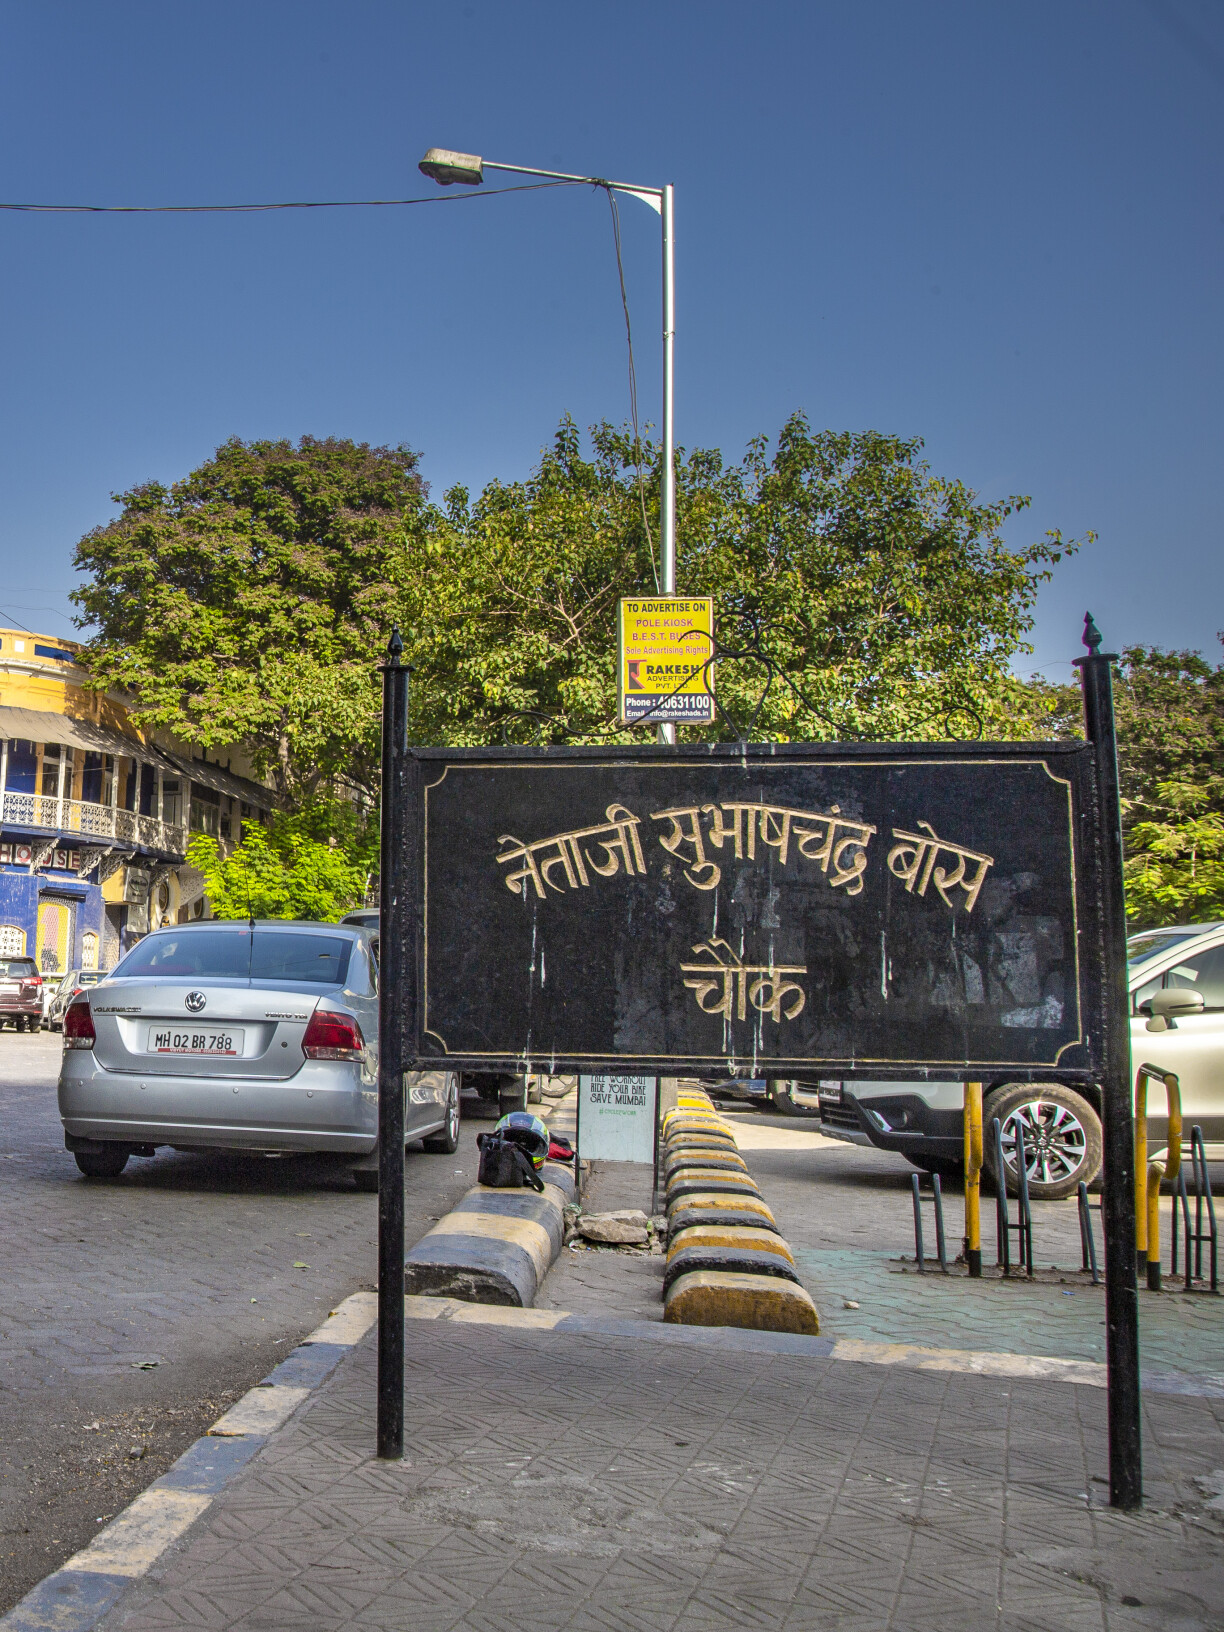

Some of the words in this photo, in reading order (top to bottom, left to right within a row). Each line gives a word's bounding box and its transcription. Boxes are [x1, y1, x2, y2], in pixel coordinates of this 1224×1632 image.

[627, 604, 639, 612] TO
[641, 603, 690, 612] ADVERTISE
[693, 603, 706, 612] ON
[636, 619, 660, 627] POLE
[663, 619, 694, 627] KIOSK
[632, 632, 666, 641] B.E.S.T.
[669, 631, 701, 641] BUSES
[626, 646, 641, 654] Sole
[643, 646, 684, 656] Advertising
[685, 645, 708, 656] Rights
[646, 665, 700, 674] RAKESH
[626, 698, 651, 706] Phone
[657, 696, 709, 709] 40631100
[496, 803, 647, 899] नेताजी
[649, 802, 876, 896] सुभाषचंद्र
[887, 820, 994, 913] बोस
[680, 938, 807, 1023] चौक
[155, 1033, 171, 1048] MH
[173, 1034, 189, 1048] 02
[191, 1035, 206, 1049] BR
[209, 1035, 232, 1050] 788
[590, 1083, 605, 1093] RIDE
[608, 1083, 629, 1095] YOUR
[632, 1085, 647, 1095] BIKE
[590, 1093, 612, 1104] SAVE
[615, 1095, 646, 1106] MUMBAI
